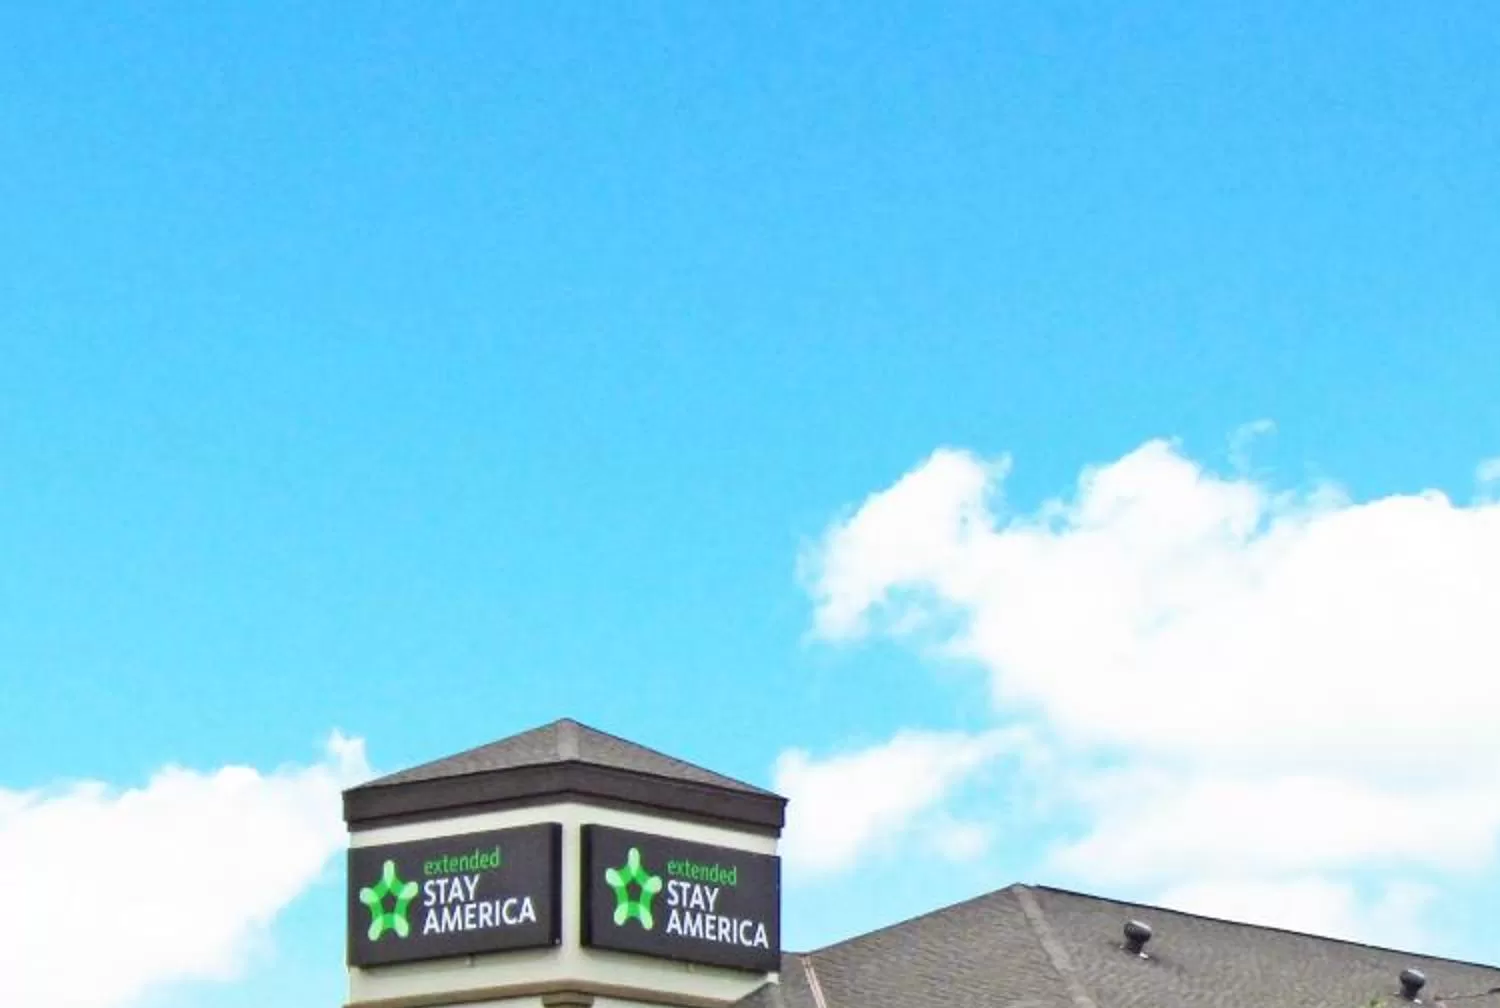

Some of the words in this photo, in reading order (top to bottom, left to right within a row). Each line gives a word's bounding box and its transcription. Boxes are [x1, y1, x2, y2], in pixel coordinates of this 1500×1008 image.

[423, 846, 501, 873] extended
[666, 859, 738, 884] extended
[422, 874, 480, 907] STAY
[666, 880, 719, 912] STAY
[422, 897, 537, 935] AMERICA
[665, 912, 770, 949] AMERICA
